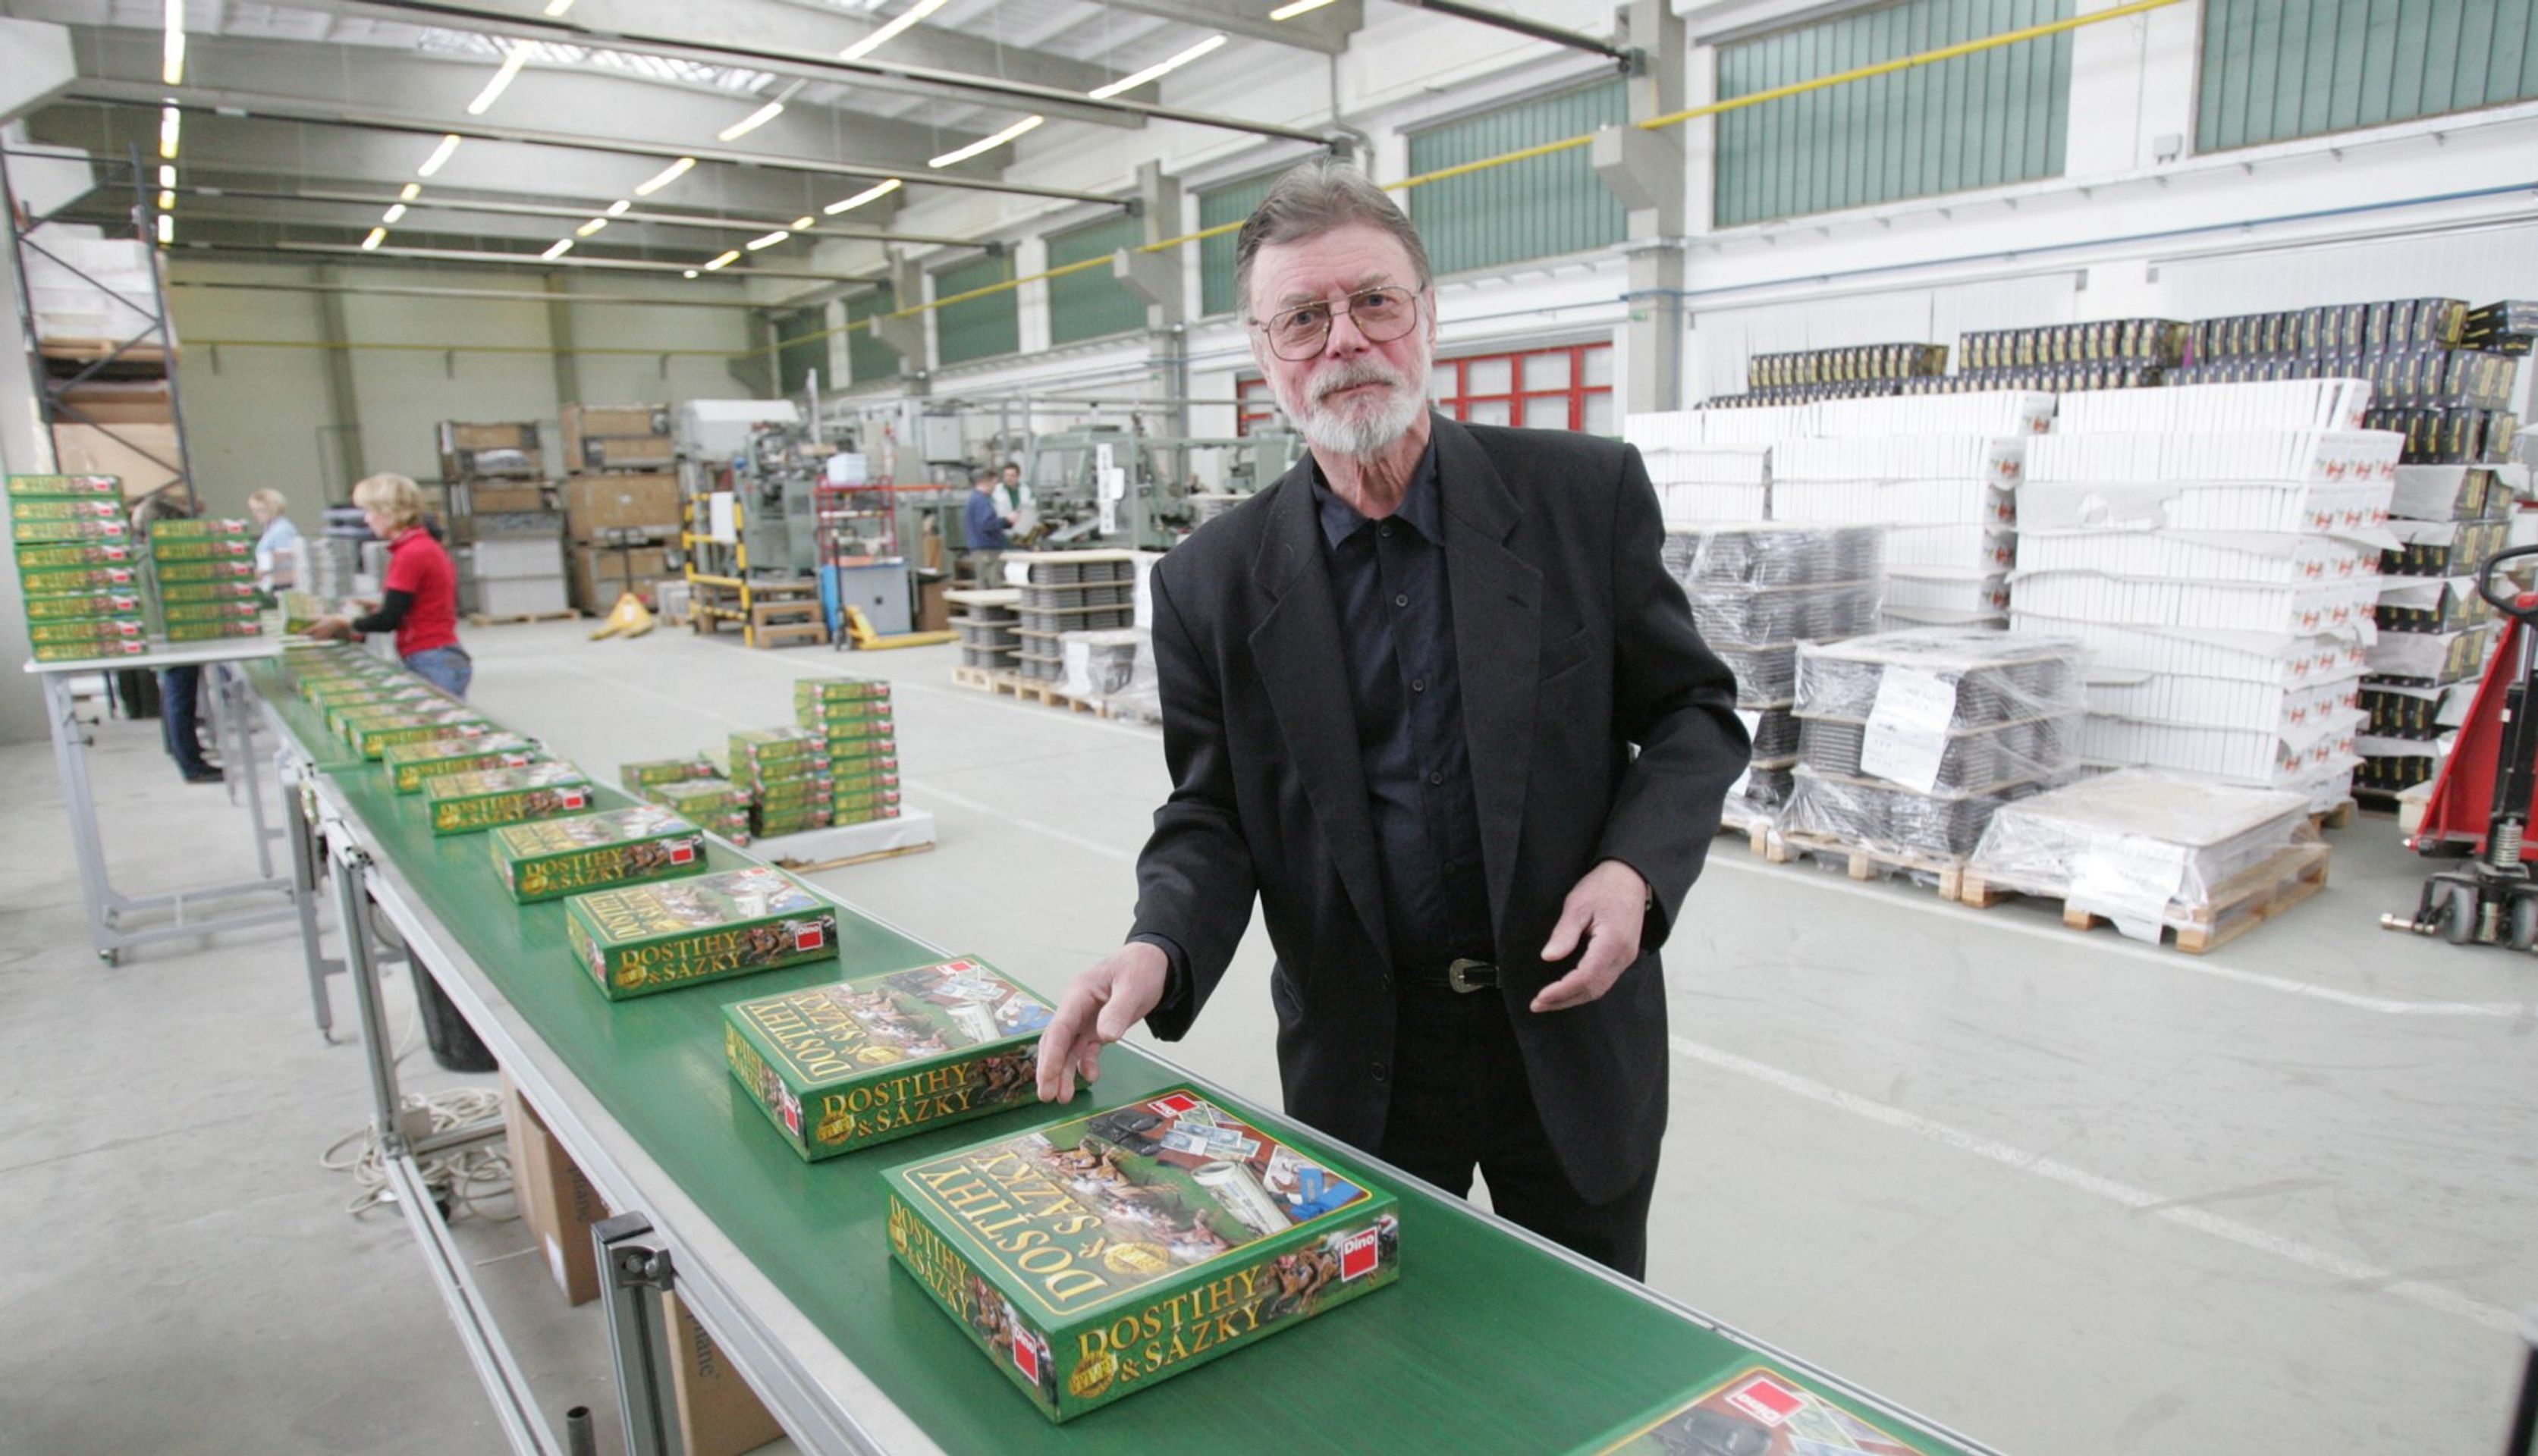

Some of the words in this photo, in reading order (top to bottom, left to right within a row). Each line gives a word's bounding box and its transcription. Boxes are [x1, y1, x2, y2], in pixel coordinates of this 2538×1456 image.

[525, 848, 624, 874] DOSTIHY
[620, 931, 740, 965] DOSTIHY
[747, 1002, 852, 1077] DOSTIHY
[822, 1062, 970, 1116] DOSTIHY
[858, 1119, 873, 1137] &
[877, 1087, 973, 1132] SÁZKY
[890, 1194, 968, 1289] DOSTIHY
[917, 1165, 1108, 1301] DOSTIHY
[1078, 1237, 1106, 1259] &
[1344, 1235, 1374, 1255] Dino
[1077, 1265, 1262, 1359] DOSTIHY
[1119, 1357, 1142, 1381] &
[1144, 1298, 1265, 1374] SÁZKY
